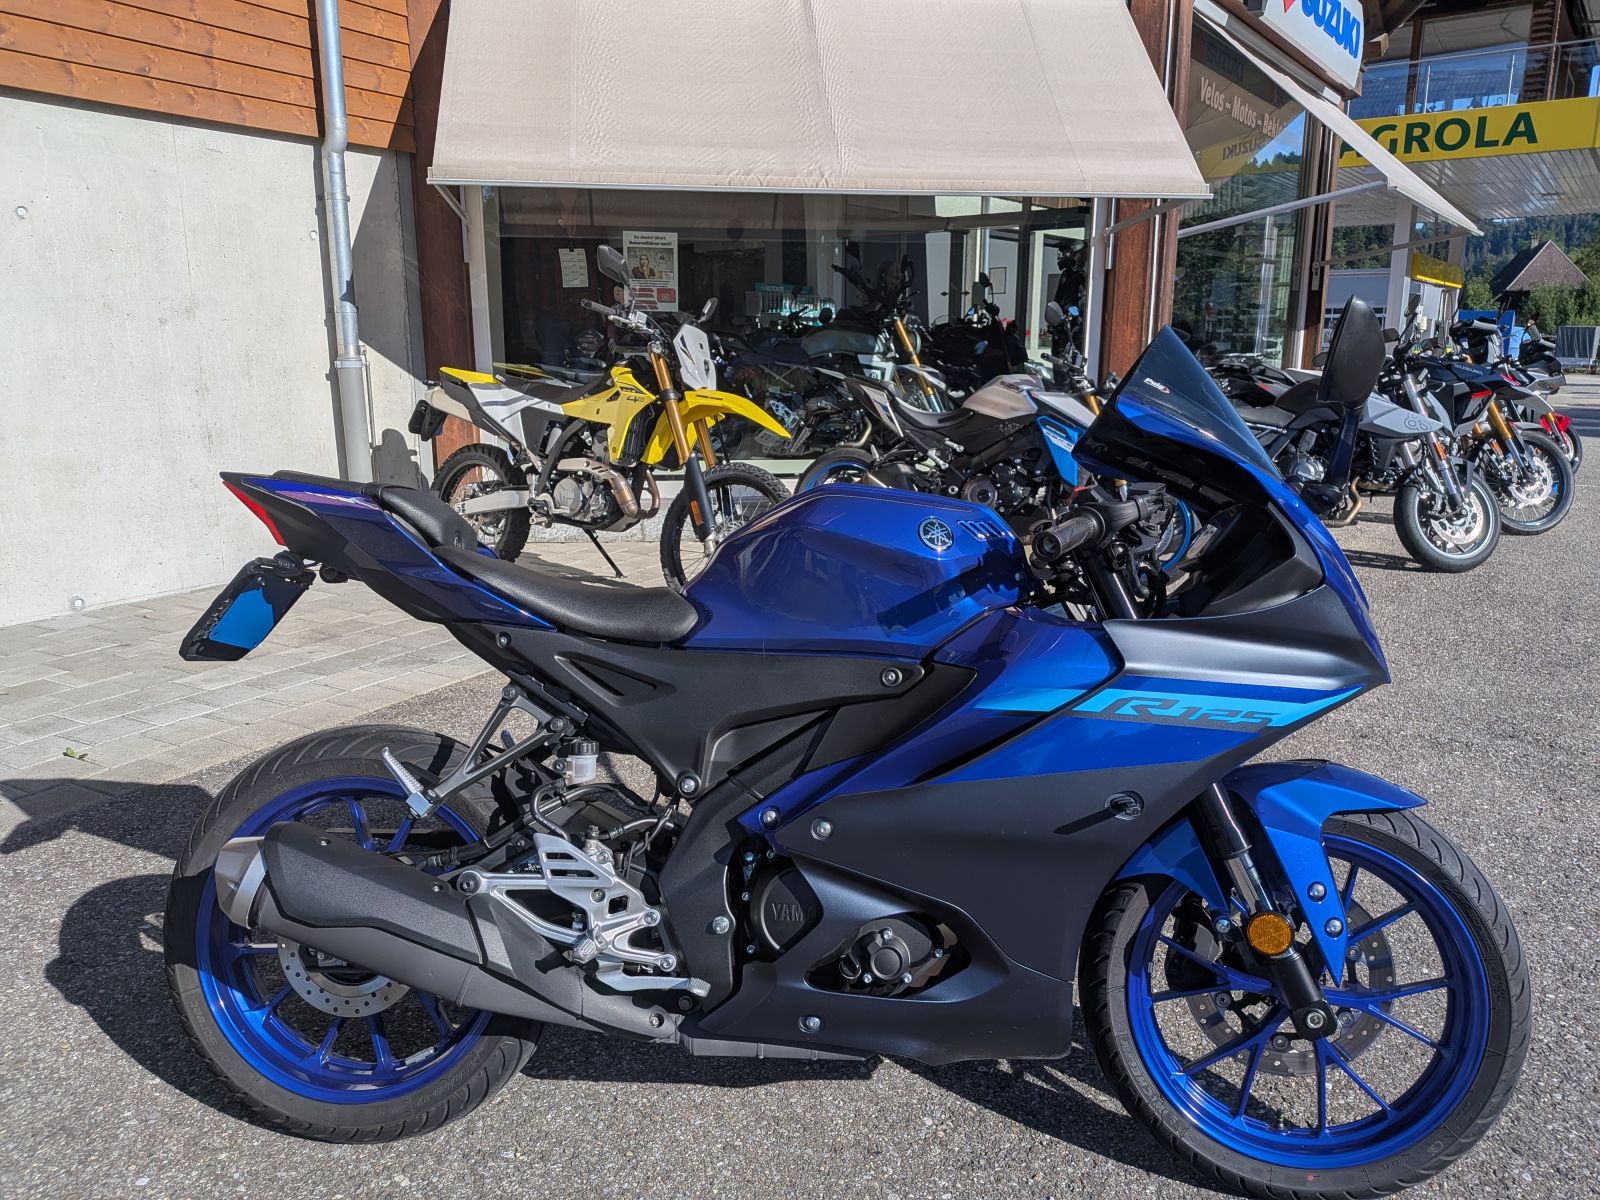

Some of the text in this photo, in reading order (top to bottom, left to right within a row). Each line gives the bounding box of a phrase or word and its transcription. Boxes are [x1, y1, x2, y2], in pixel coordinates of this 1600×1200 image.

[1201, 76, 1225, 112] Velos
[1231, 95, 1257, 129] Motos
[1000, 380, 1024, 393] SUZUKI
[1102, 696, 1281, 730] R125
[771, 903, 819, 922] YAMA
